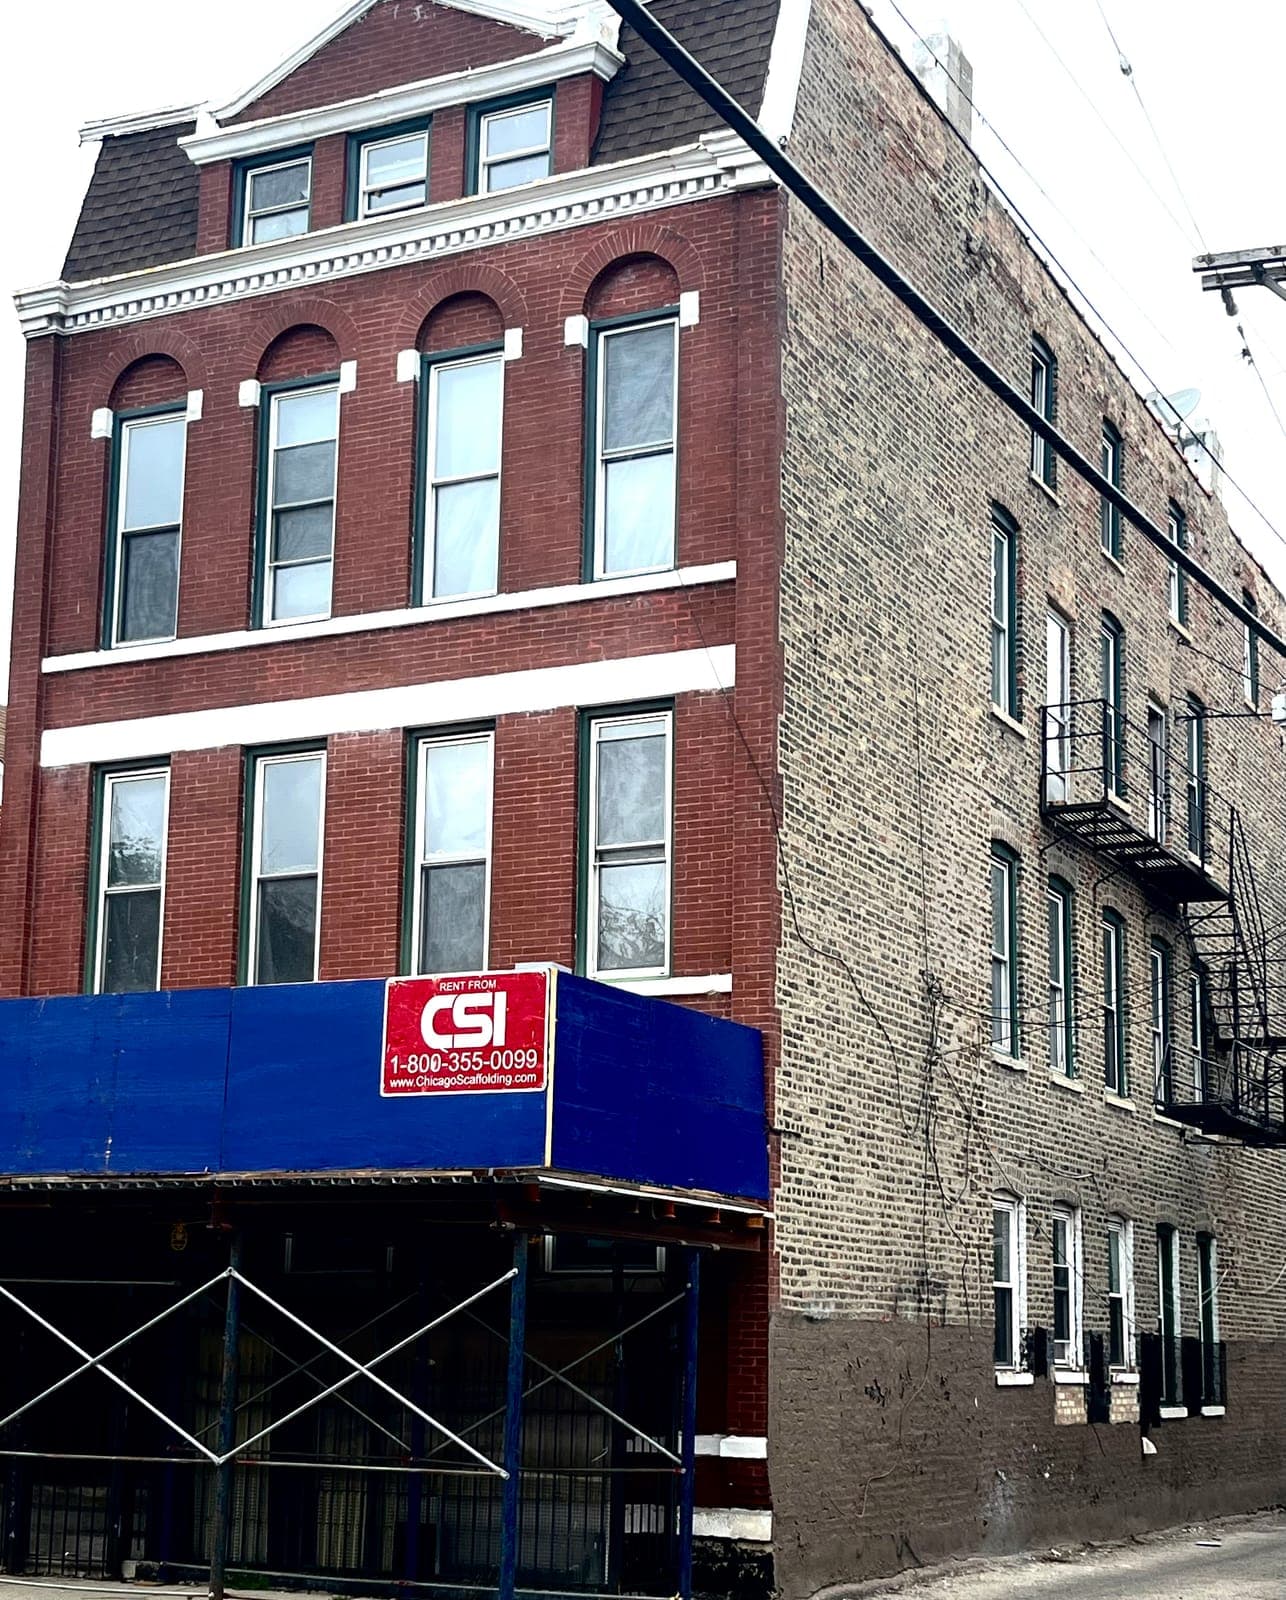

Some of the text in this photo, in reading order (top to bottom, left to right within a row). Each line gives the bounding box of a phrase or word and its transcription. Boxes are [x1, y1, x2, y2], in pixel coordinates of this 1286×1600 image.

[439, 979, 497, 992] RENT FROM
[420, 991, 507, 1050] CSI
[390, 1049, 538, 1074] 1-800-355-0099
[389, 1073, 537, 1088] www.ChicagoScaffolding.com
